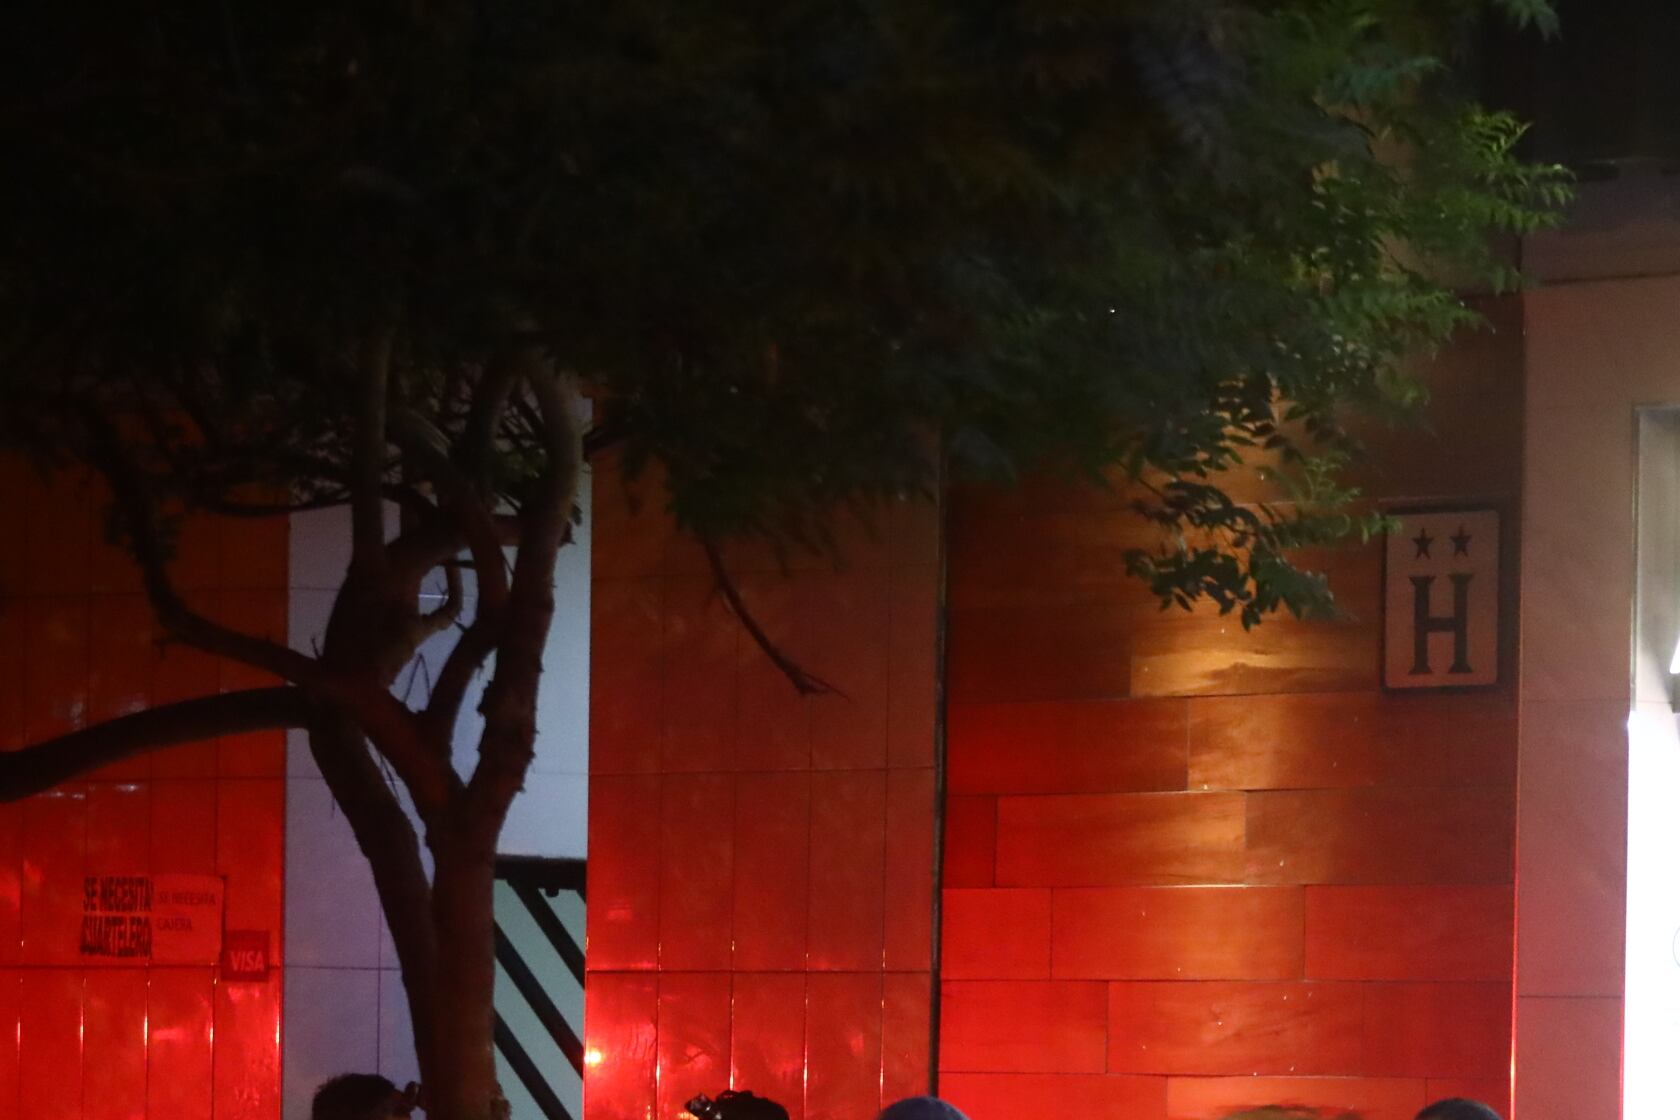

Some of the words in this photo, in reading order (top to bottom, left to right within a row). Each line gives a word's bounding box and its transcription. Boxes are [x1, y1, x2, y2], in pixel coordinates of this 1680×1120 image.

[1408, 573, 1474, 675] H
[84, 876, 98, 912] SE
[101, 876, 152, 912] NECESITA
[230, 951, 265, 972] VISA
